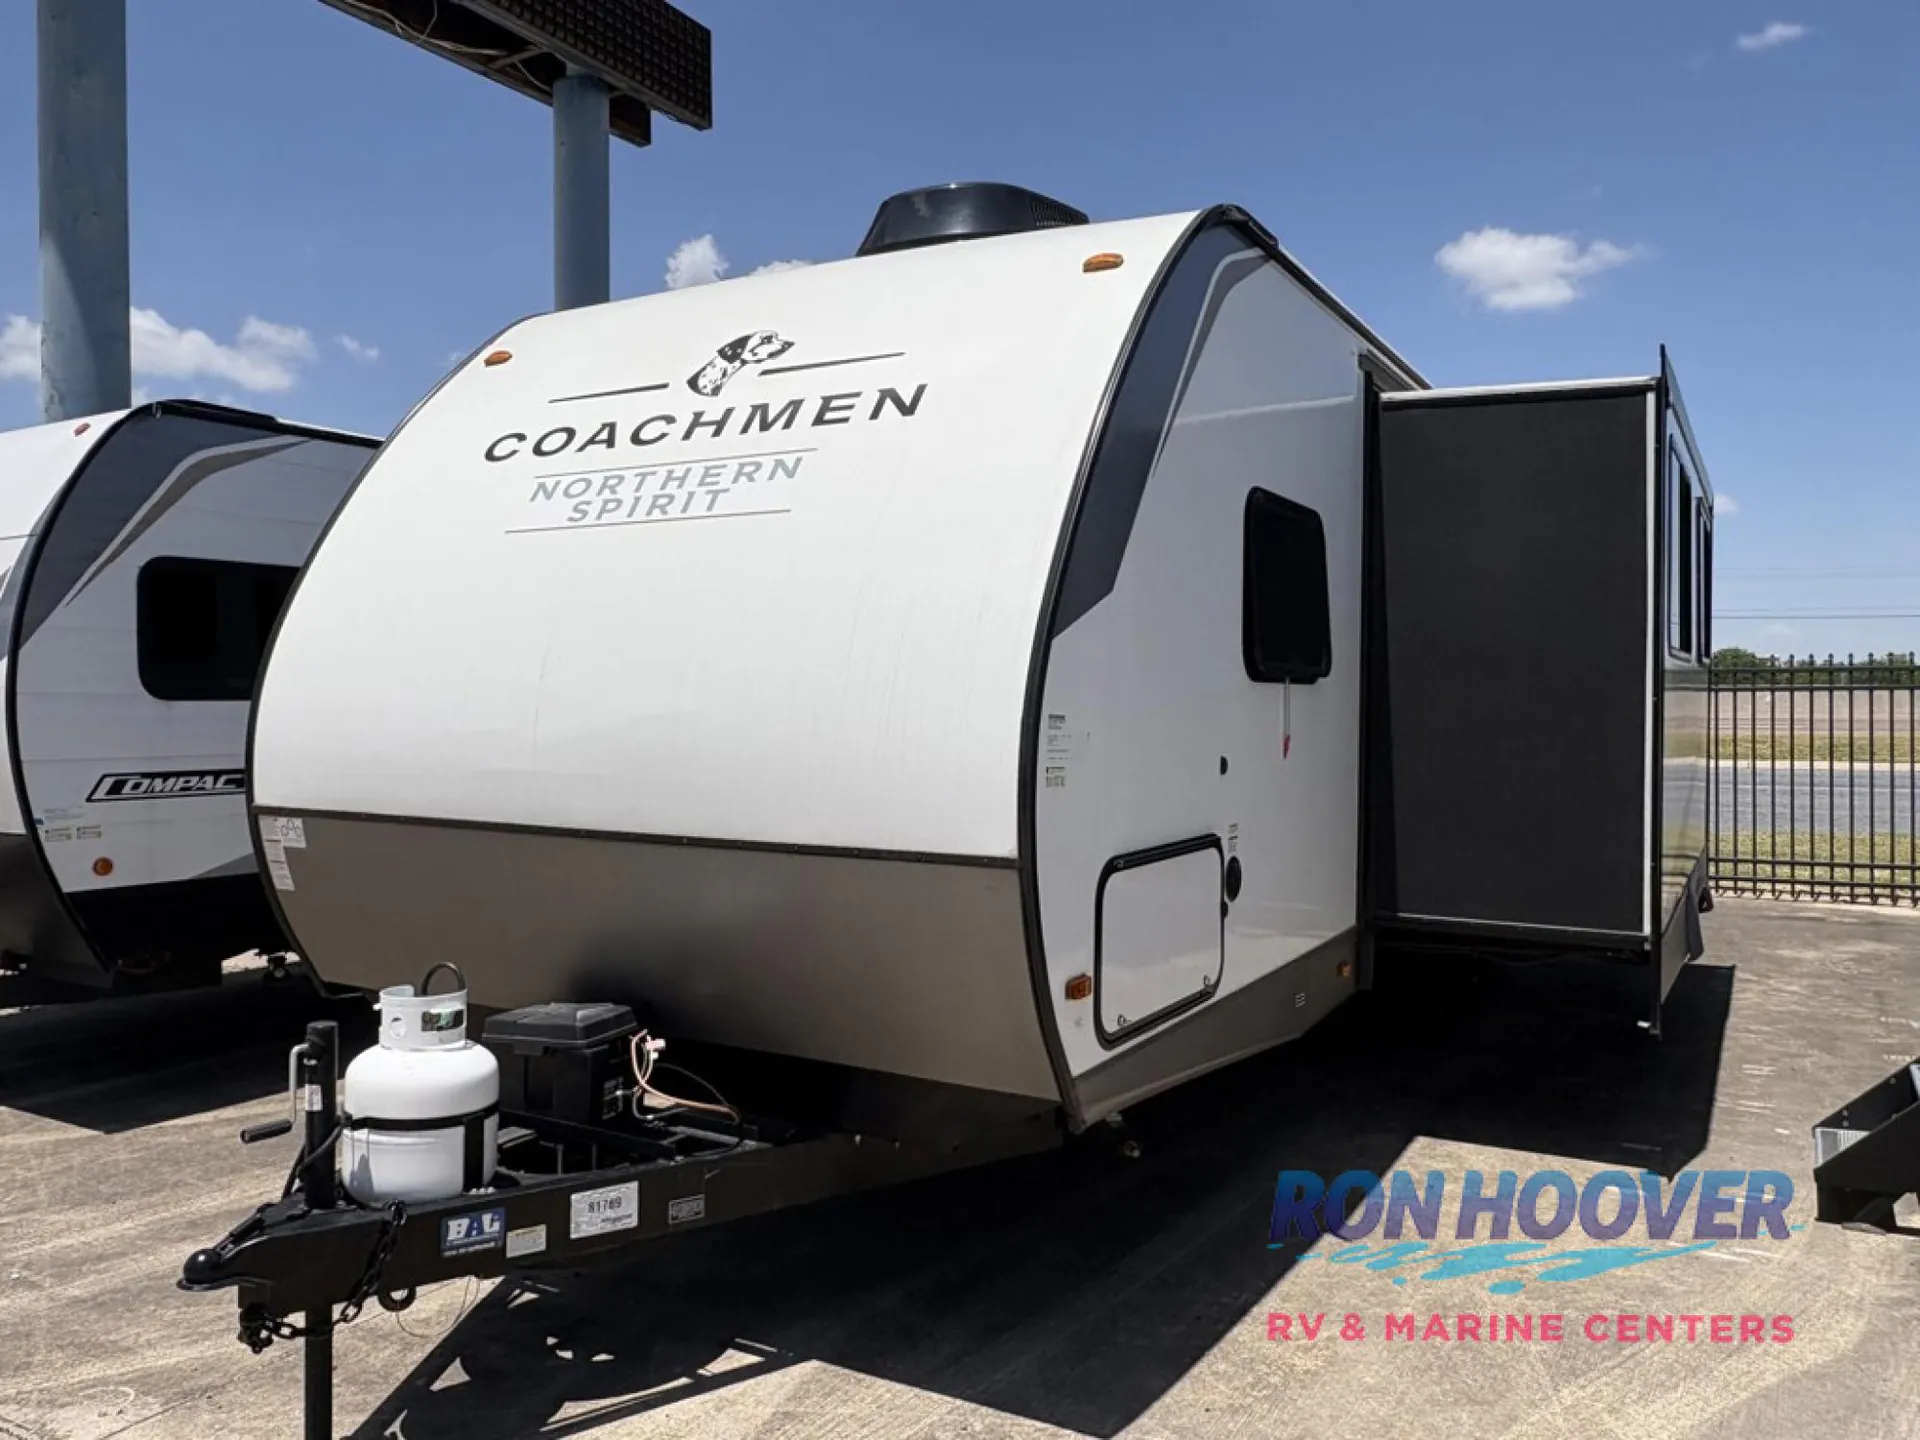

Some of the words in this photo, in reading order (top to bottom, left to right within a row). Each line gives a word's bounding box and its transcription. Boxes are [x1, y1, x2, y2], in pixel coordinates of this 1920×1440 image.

[485, 383, 928, 462] COACHMEN
[529, 456, 804, 502] NORTHERN
[566, 488, 731, 523] SPIRIT
[91, 774, 245, 800] COMPAC
